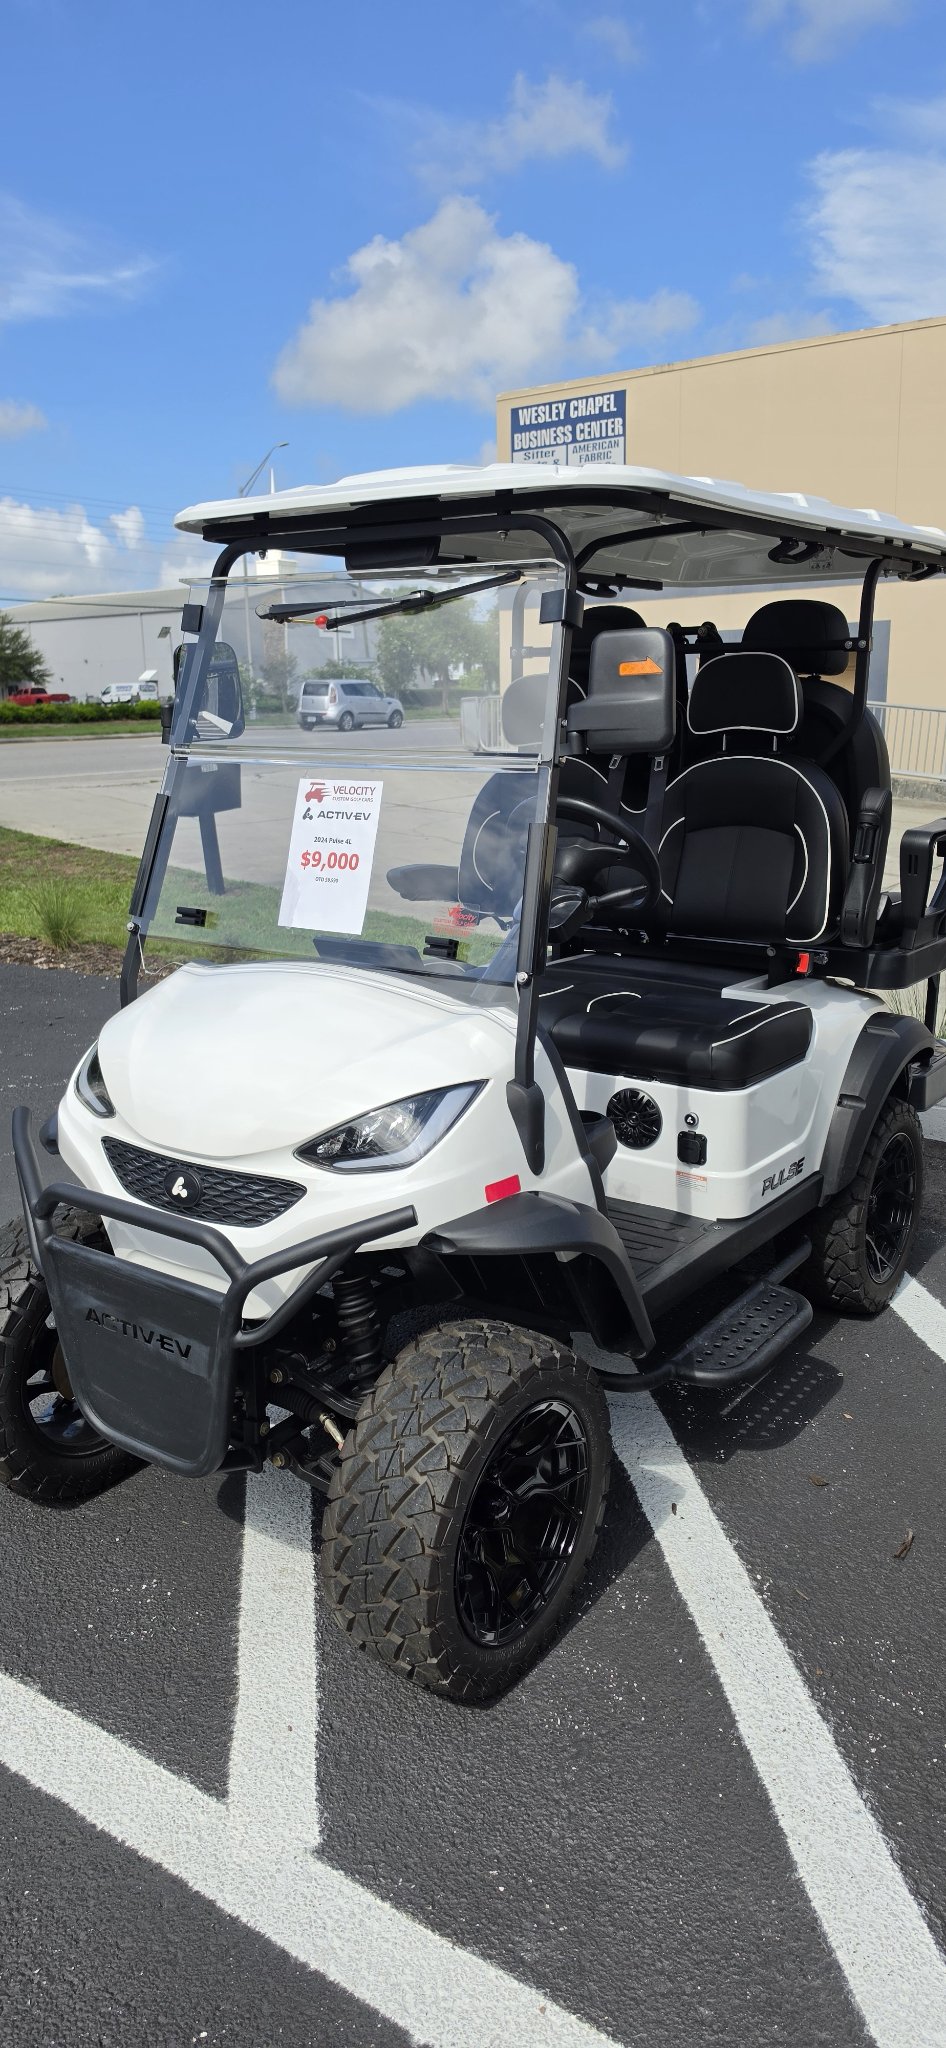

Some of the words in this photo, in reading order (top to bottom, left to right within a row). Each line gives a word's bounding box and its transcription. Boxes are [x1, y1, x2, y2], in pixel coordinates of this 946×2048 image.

[519, 402, 566, 426] WESLEY
[570, 394, 616, 418] CHAPEL
[514, 424, 573, 450] BUSINESS
[576, 417, 623, 441] CENTER
[573, 440, 619, 454] AMERICAN
[523, 449, 556, 461] Sifter
[579, 450, 612, 464] FABRIC
[333, 785, 376, 795] VELOCITY
[313, 836, 328, 844] 2024
[328, 837, 344, 845] Pulse
[301, 850, 359, 871] $9,000
[761, 1156, 806, 1197] PULSE
